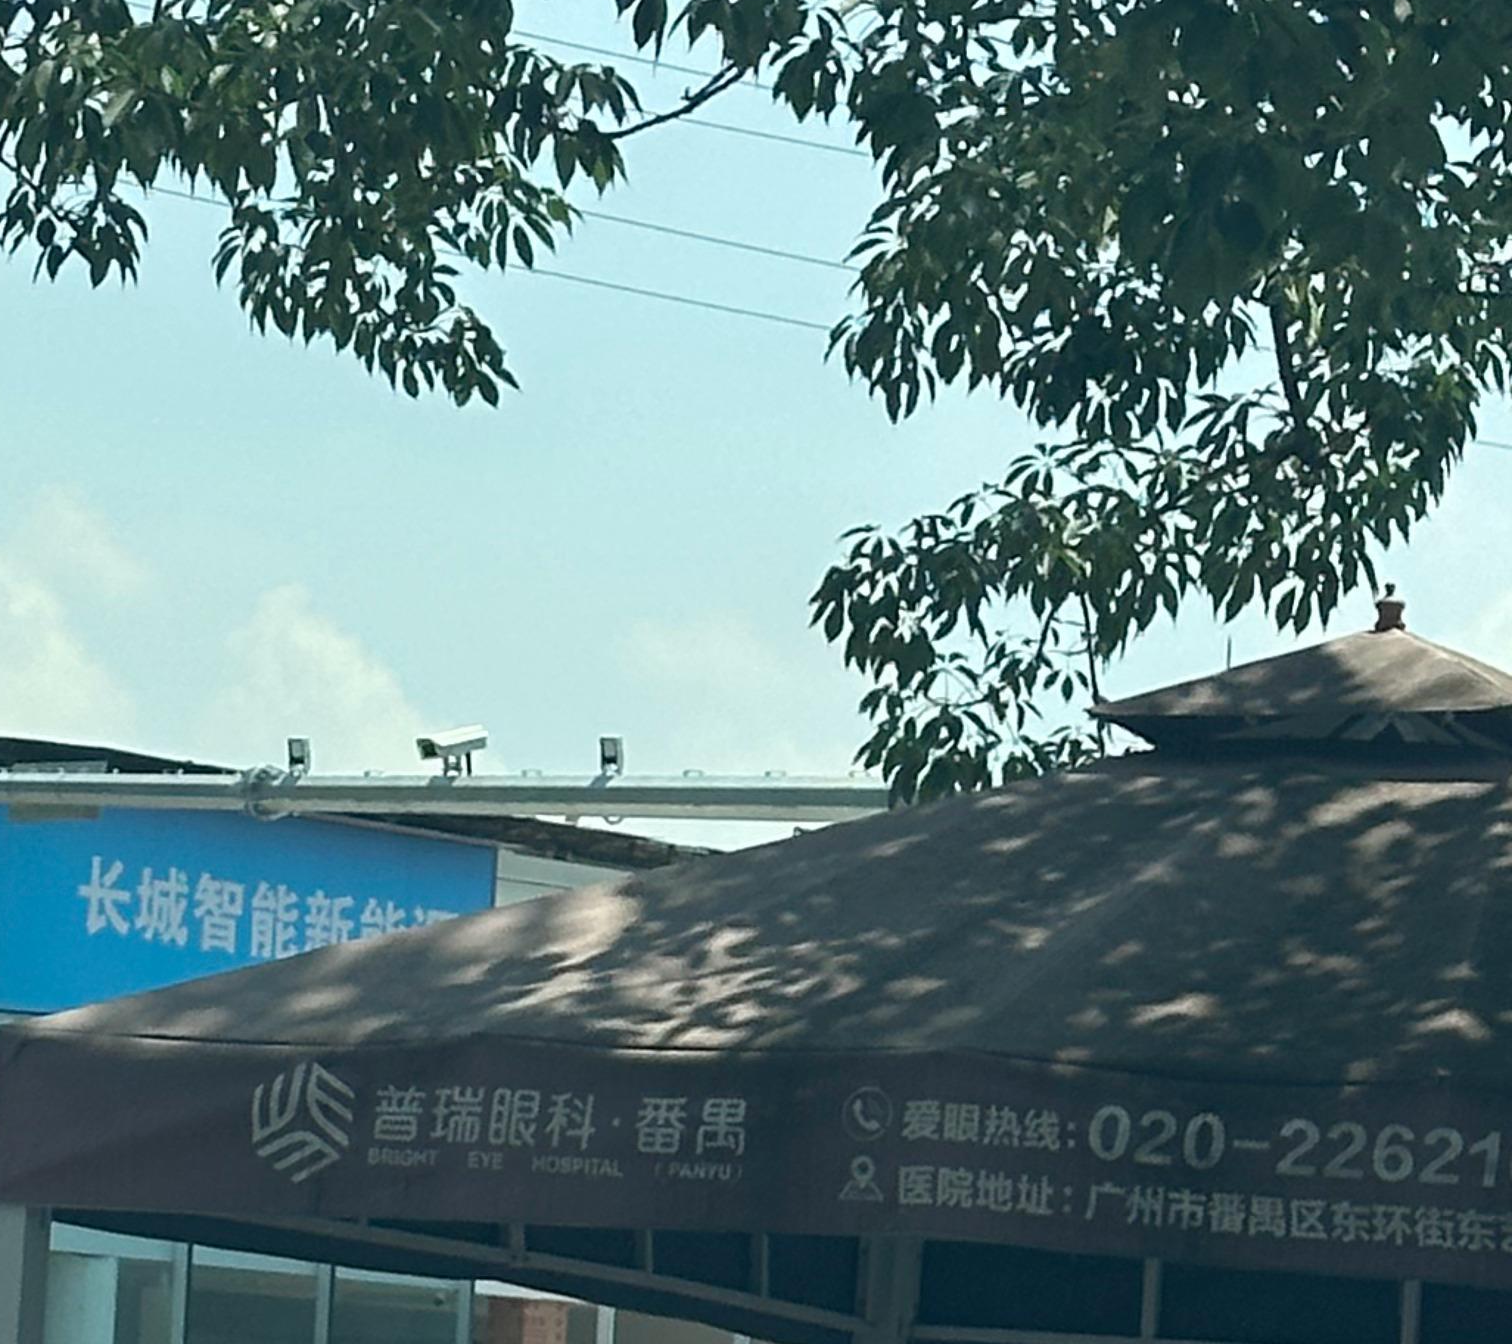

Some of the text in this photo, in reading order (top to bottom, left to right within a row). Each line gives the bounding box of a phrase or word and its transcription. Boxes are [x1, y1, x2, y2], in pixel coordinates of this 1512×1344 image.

[467, 1152, 503, 1170] EYE
[531, 1156, 624, 1178] HOSPITAL
[1087, 1104, 1512, 1189] 020-22621
